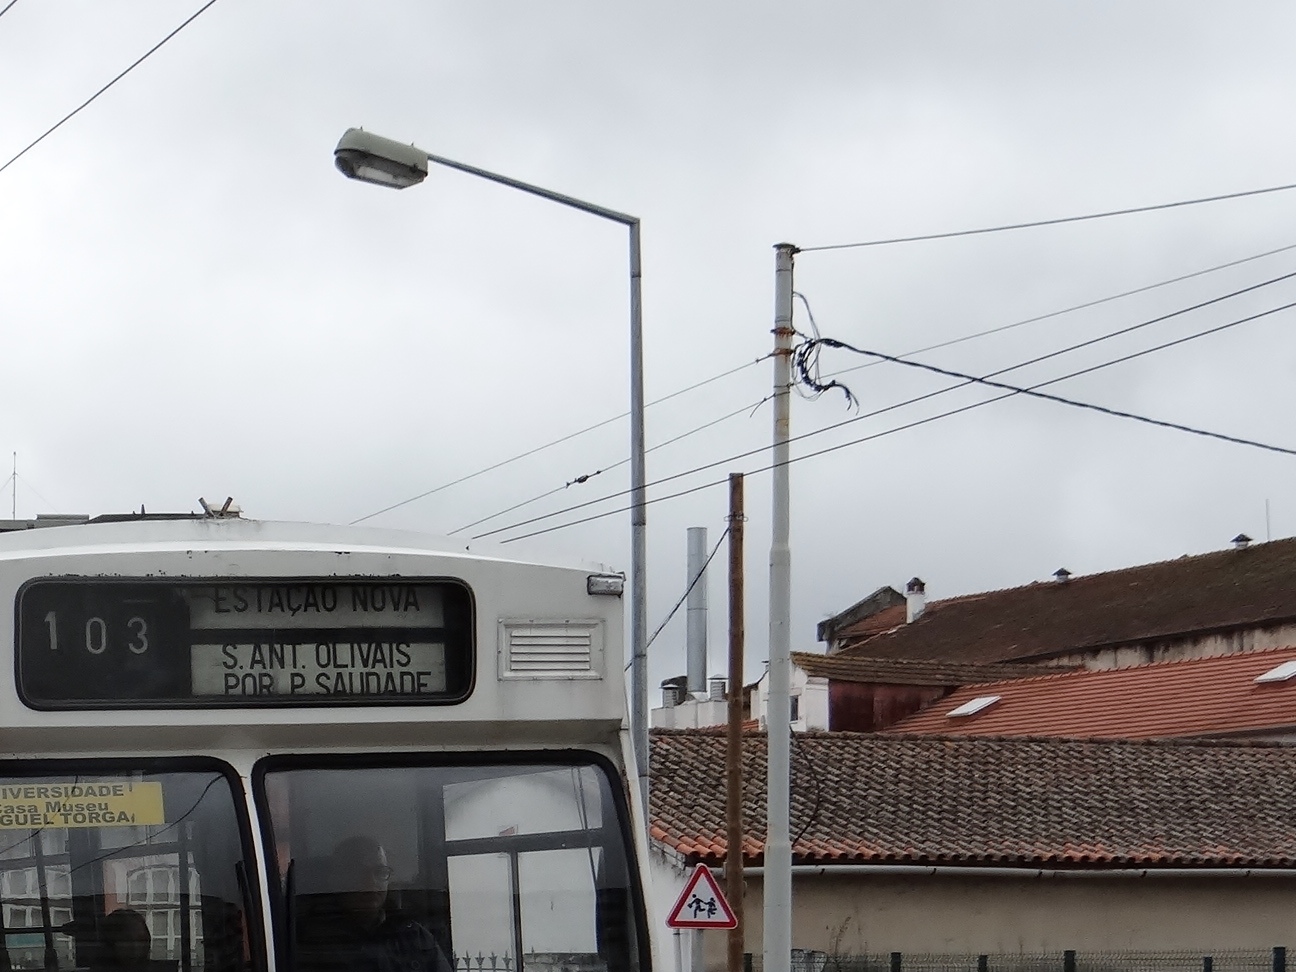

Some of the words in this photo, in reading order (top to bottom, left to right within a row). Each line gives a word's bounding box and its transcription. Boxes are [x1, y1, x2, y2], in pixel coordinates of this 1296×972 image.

[352, 585, 420, 612] NOVA
[315, 641, 411, 668] OLIVAIS
[224, 673, 274, 695] POR
[315, 671, 432, 694] SAUDADE
[45, 800, 110, 814] Museu
[59, 811, 131, 825] TORGA
